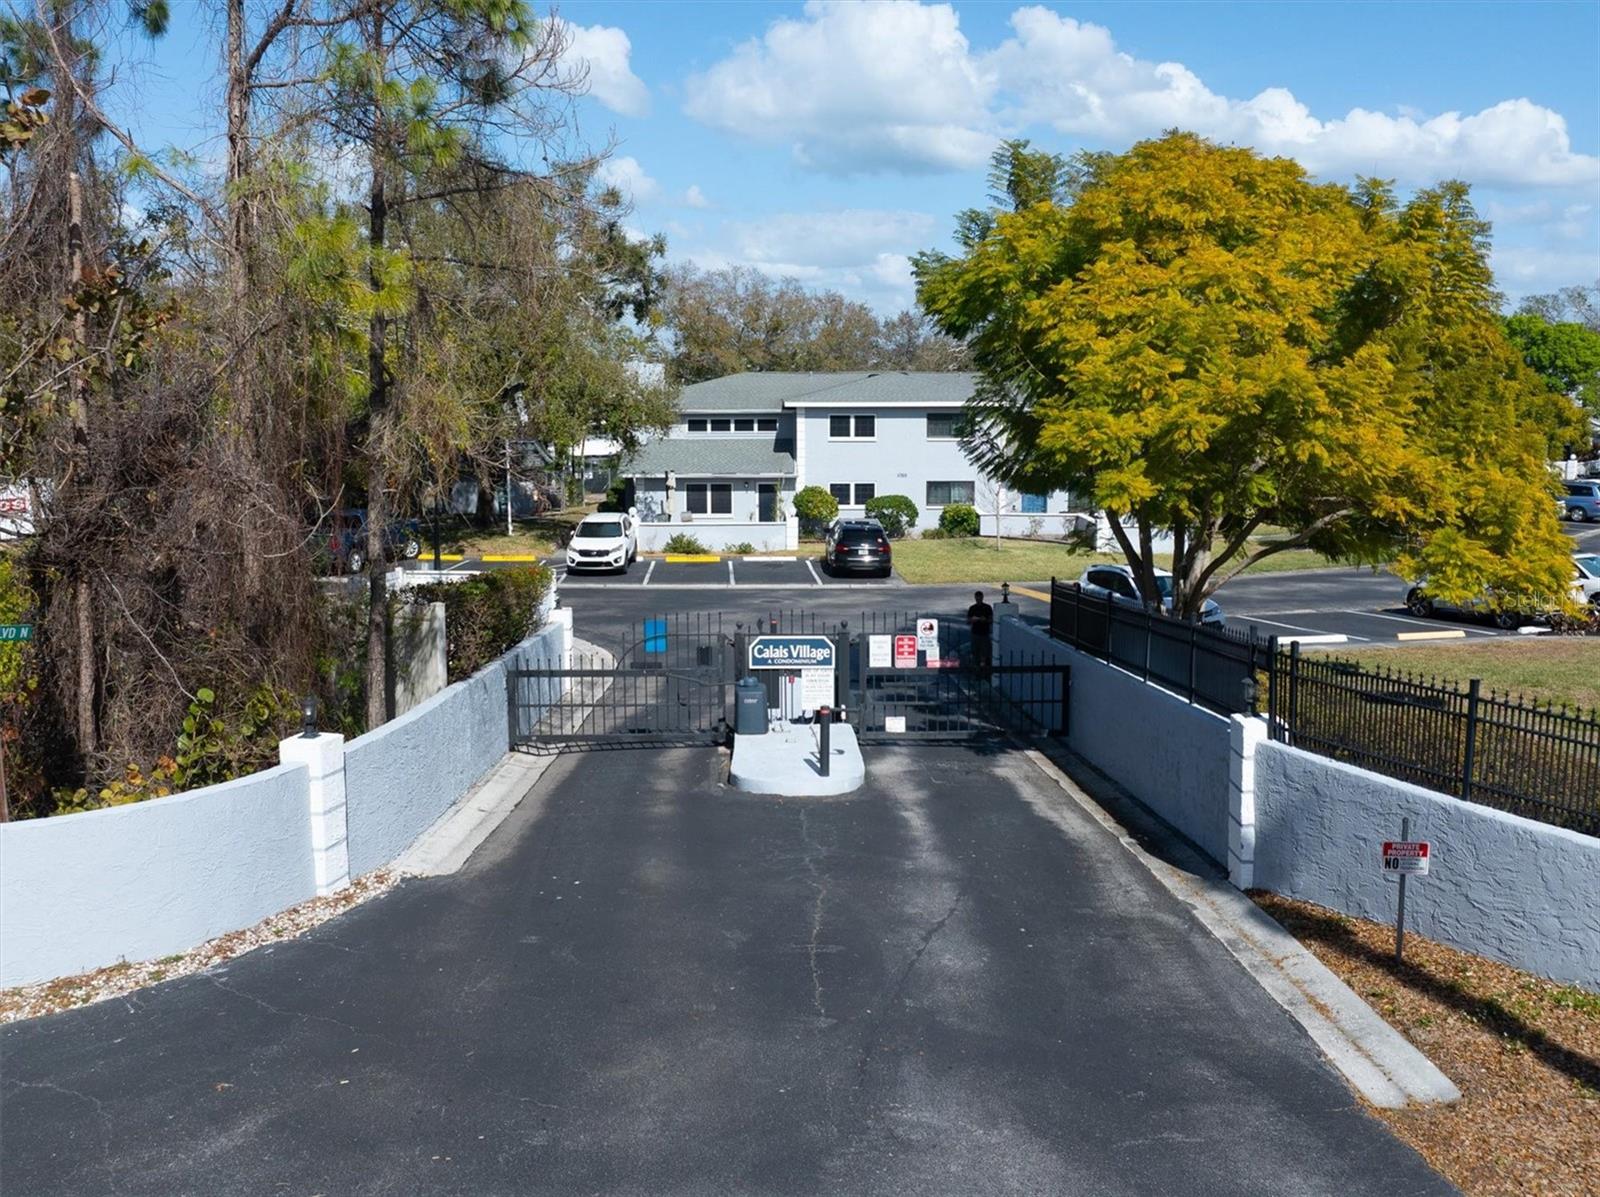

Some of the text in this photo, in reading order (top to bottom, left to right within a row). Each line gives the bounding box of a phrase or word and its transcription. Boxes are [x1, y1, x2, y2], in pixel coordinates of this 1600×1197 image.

[20, 627, 29, 639] N
[753, 644, 831, 661] Calais Village
[1387, 849, 1424, 857] PROPERTY
[1384, 857, 1400, 870] NO
